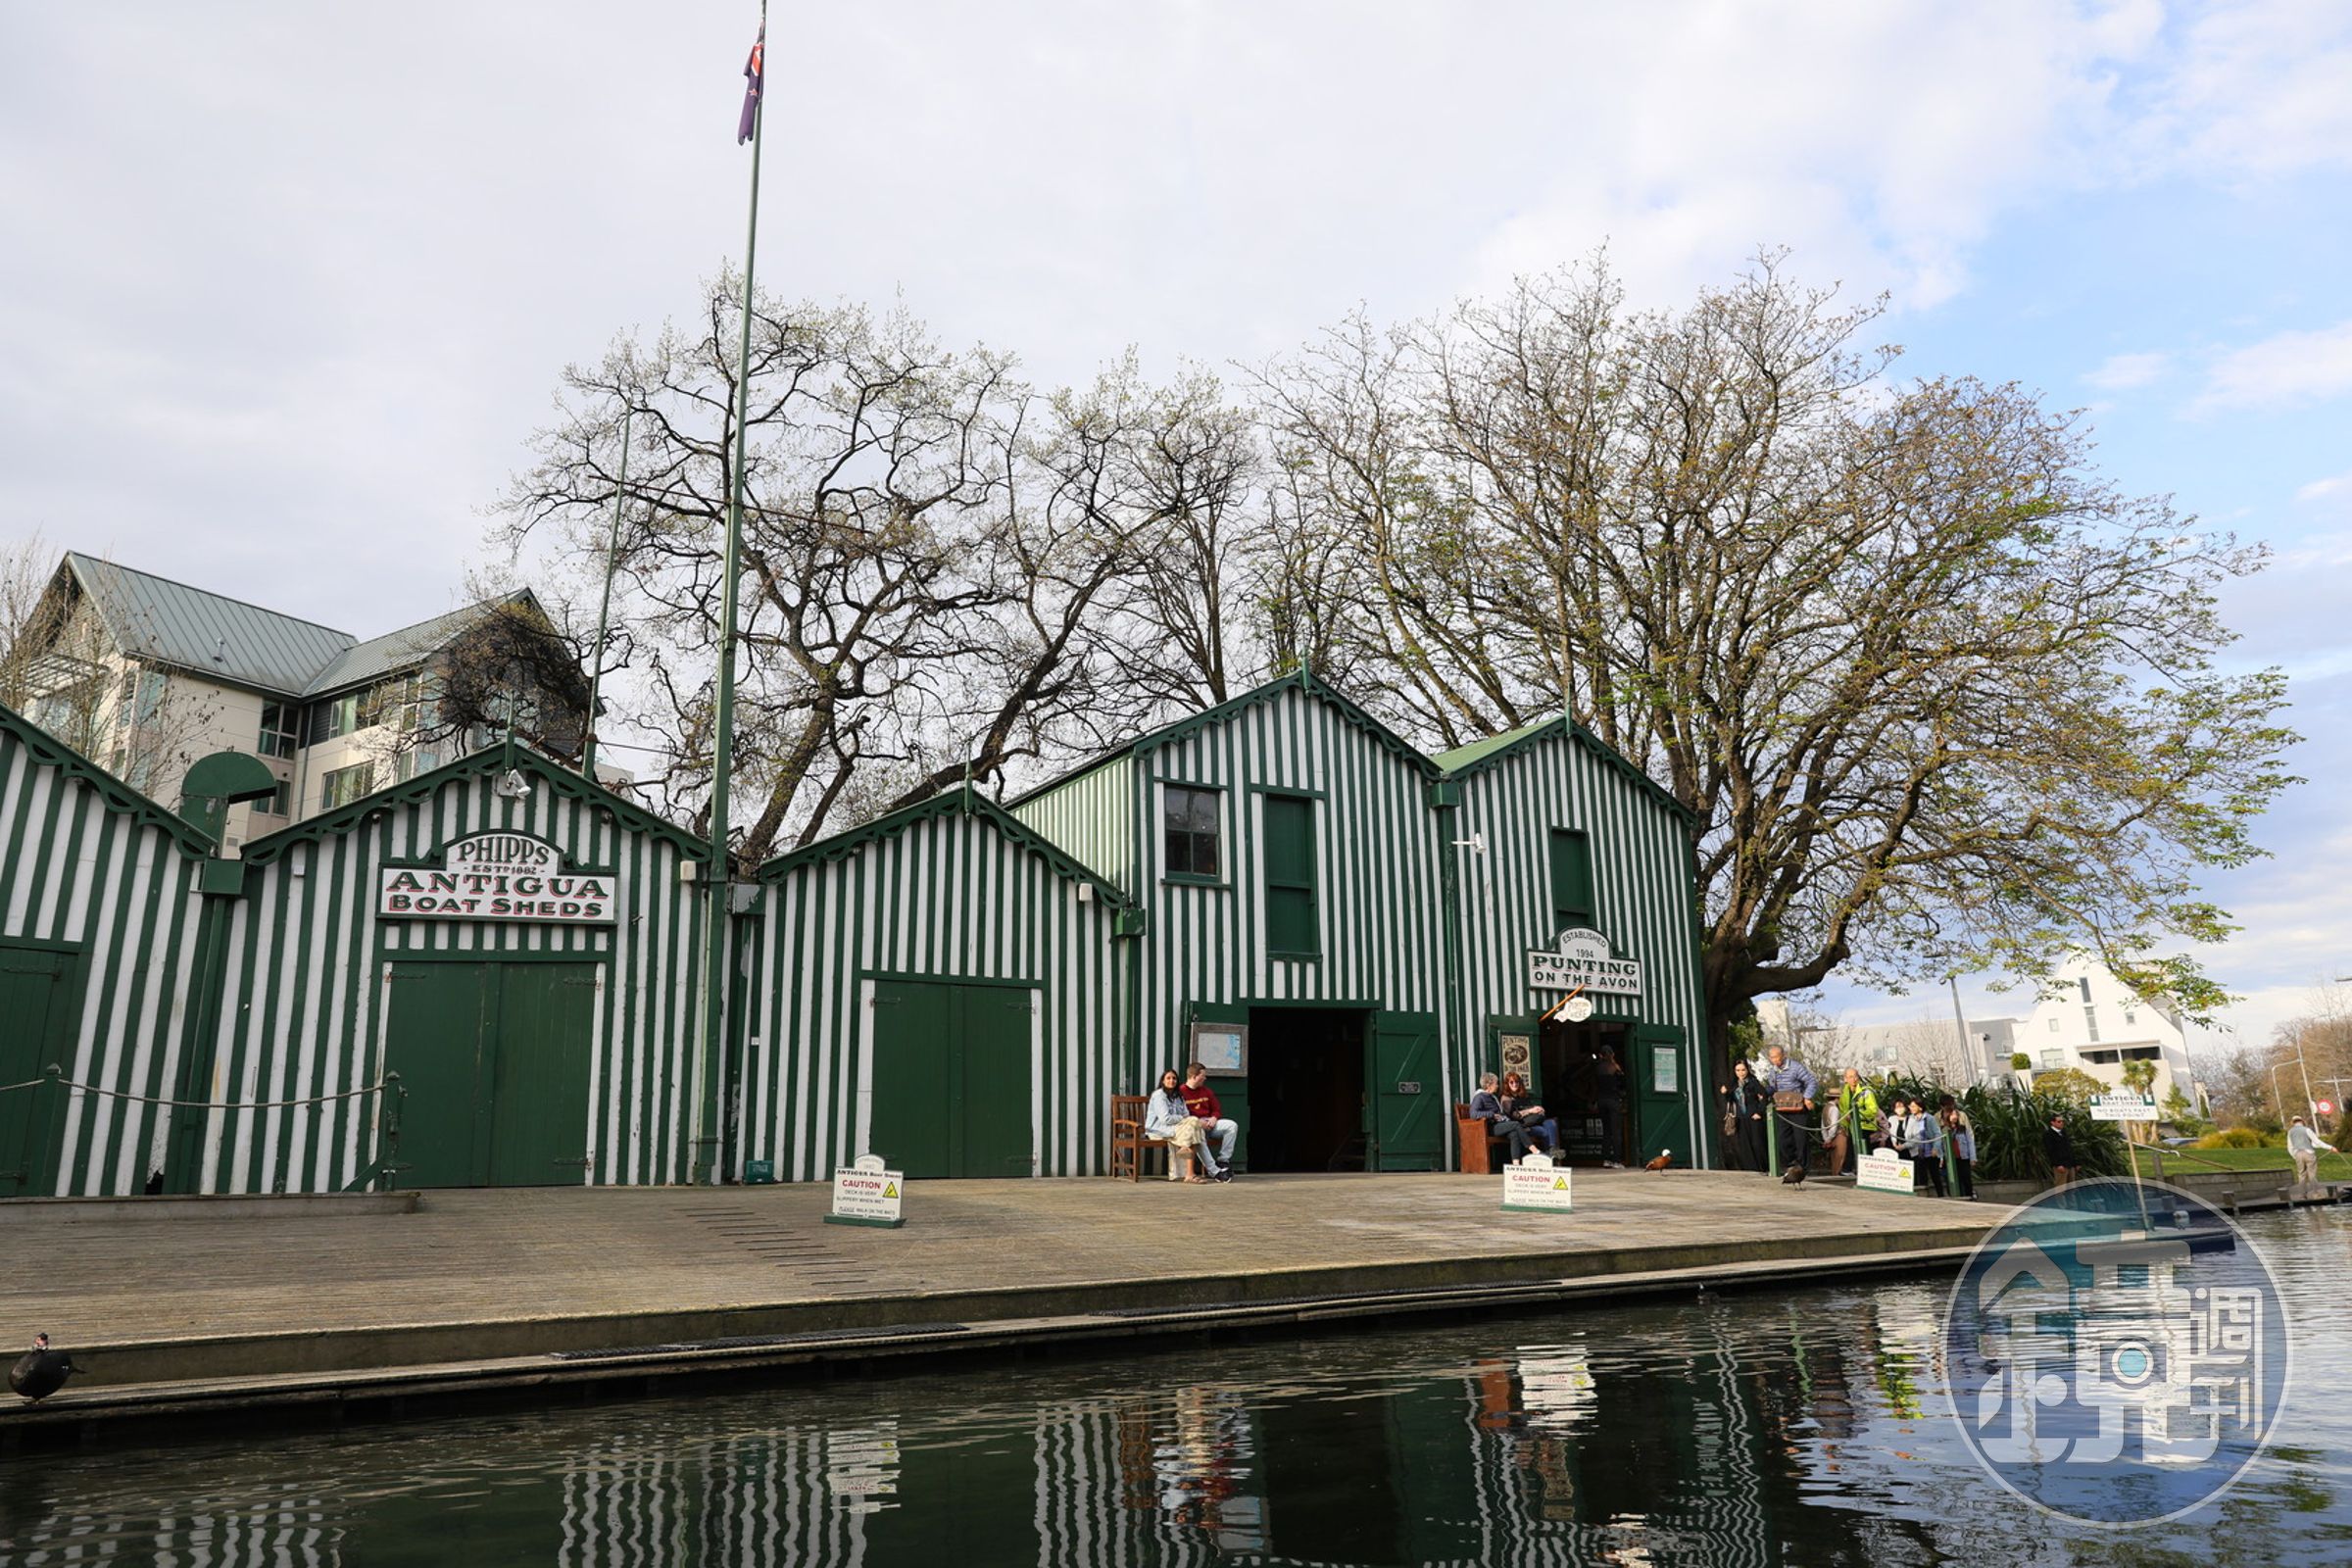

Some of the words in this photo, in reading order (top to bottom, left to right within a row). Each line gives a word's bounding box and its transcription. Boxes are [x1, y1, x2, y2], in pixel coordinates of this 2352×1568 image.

[457, 836, 549, 865] PHIPPS
[386, 871, 609, 900] ANTIGUA
[388, 894, 481, 913] BOAT
[490, 898, 603, 918] SHEDS
[1561, 930, 1607, 949] ESTABLISHED
[1576, 949, 1594, 958] 1994
[1532, 956, 1637, 977] PUNTING
[1535, 971, 1555, 983] ON
[1563, 973, 1592, 986] THE
[1599, 976, 1638, 990] AVON
[842, 1179, 881, 1189] CAUTION
